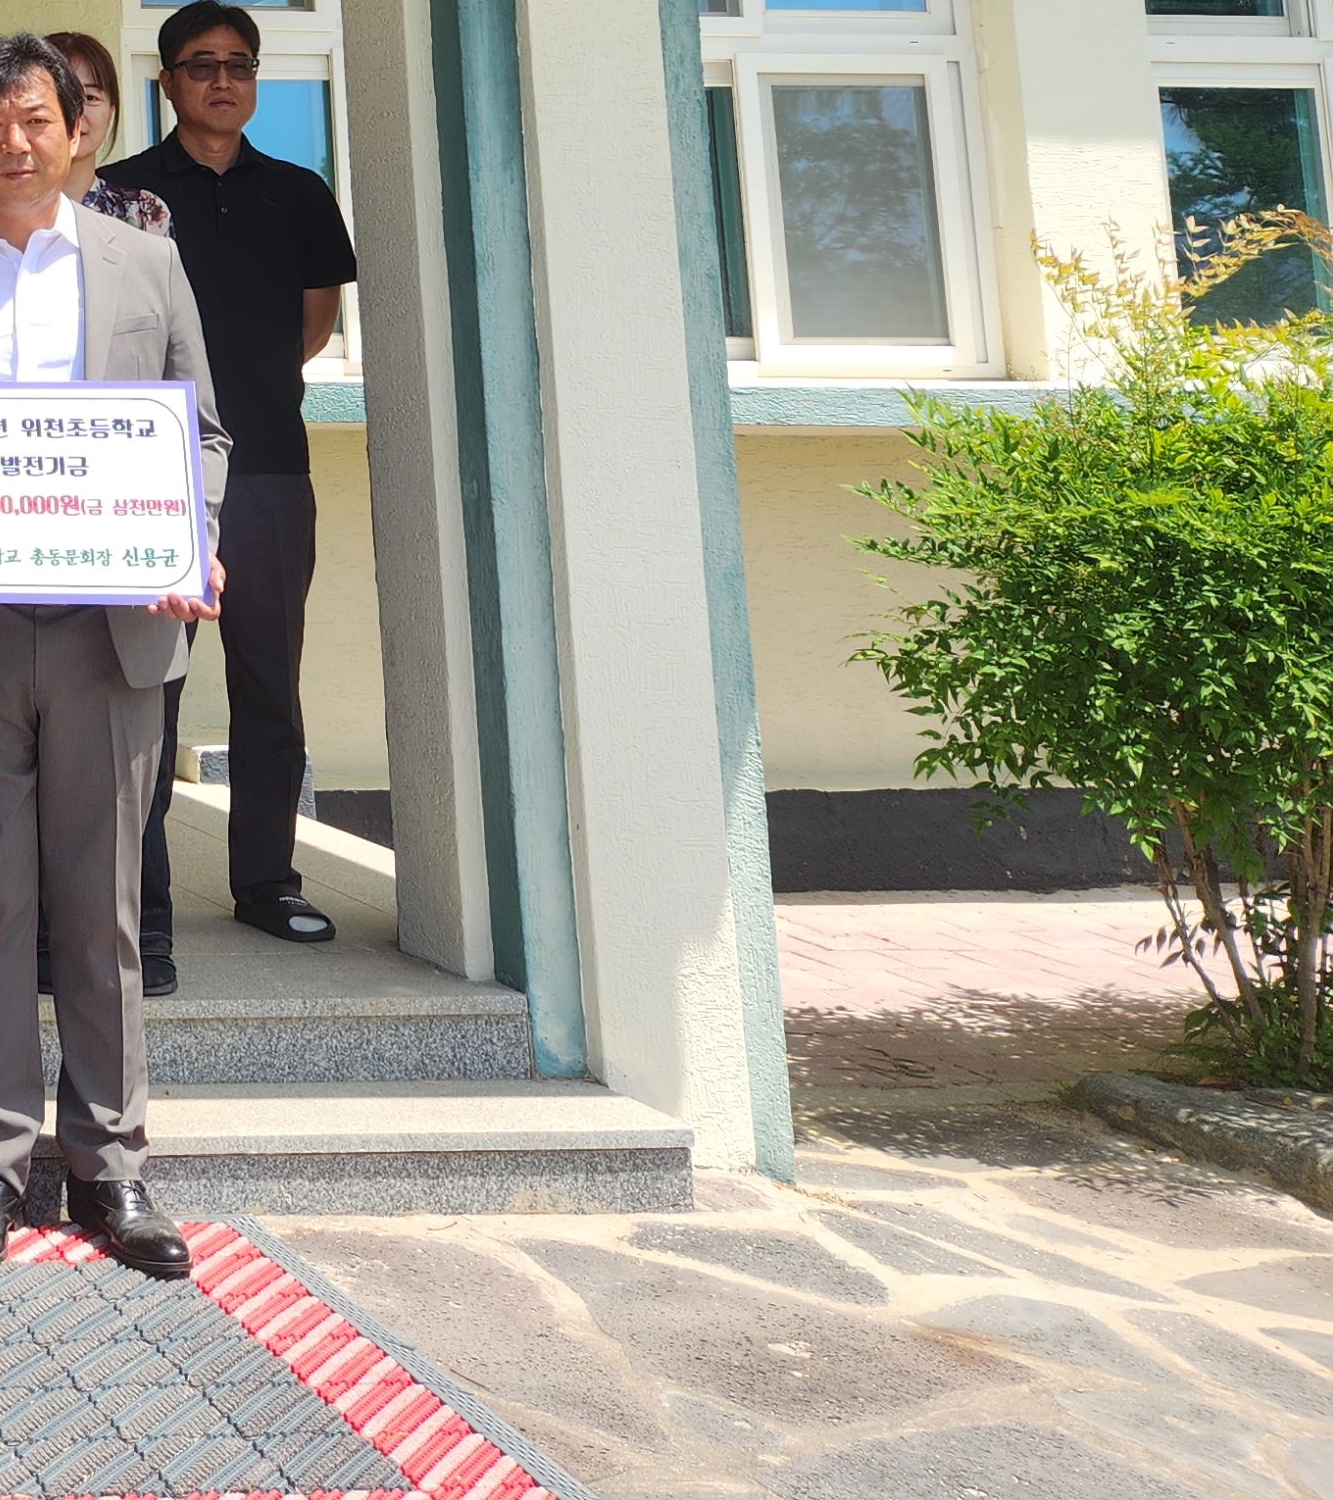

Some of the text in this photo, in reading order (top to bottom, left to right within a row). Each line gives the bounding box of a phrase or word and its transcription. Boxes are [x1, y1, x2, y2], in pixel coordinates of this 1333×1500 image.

[20, 417, 158, 439] 위천초등학교
[0, 455, 90, 478] 발전기금
[29, 547, 113, 567] 총동문회장
